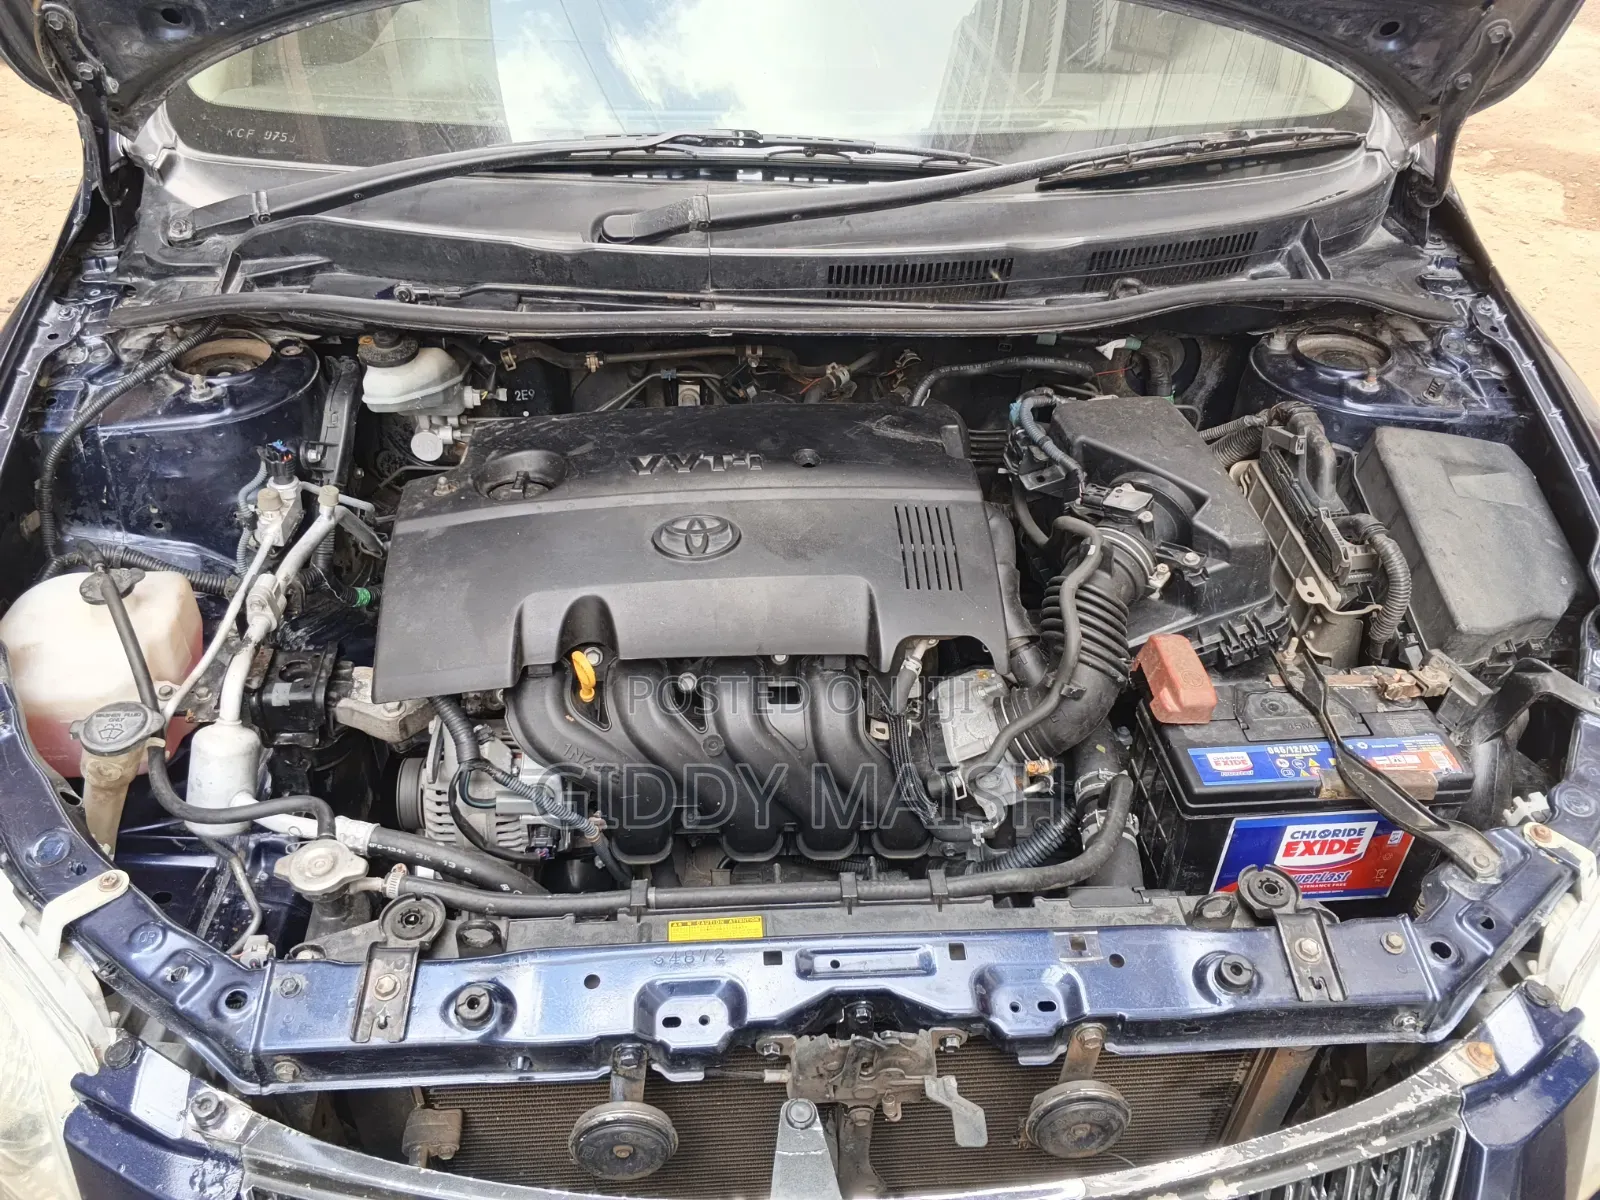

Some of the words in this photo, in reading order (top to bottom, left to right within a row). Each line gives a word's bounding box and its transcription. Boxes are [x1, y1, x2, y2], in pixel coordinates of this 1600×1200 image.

[226, 127, 255, 139] KCF
[514, 388, 535, 401] 2E9
[1213, 759, 1249, 767] EXIDE
[1290, 826, 1368, 840] CHLORIDE
[1282, 837, 1364, 858] EXIDE
